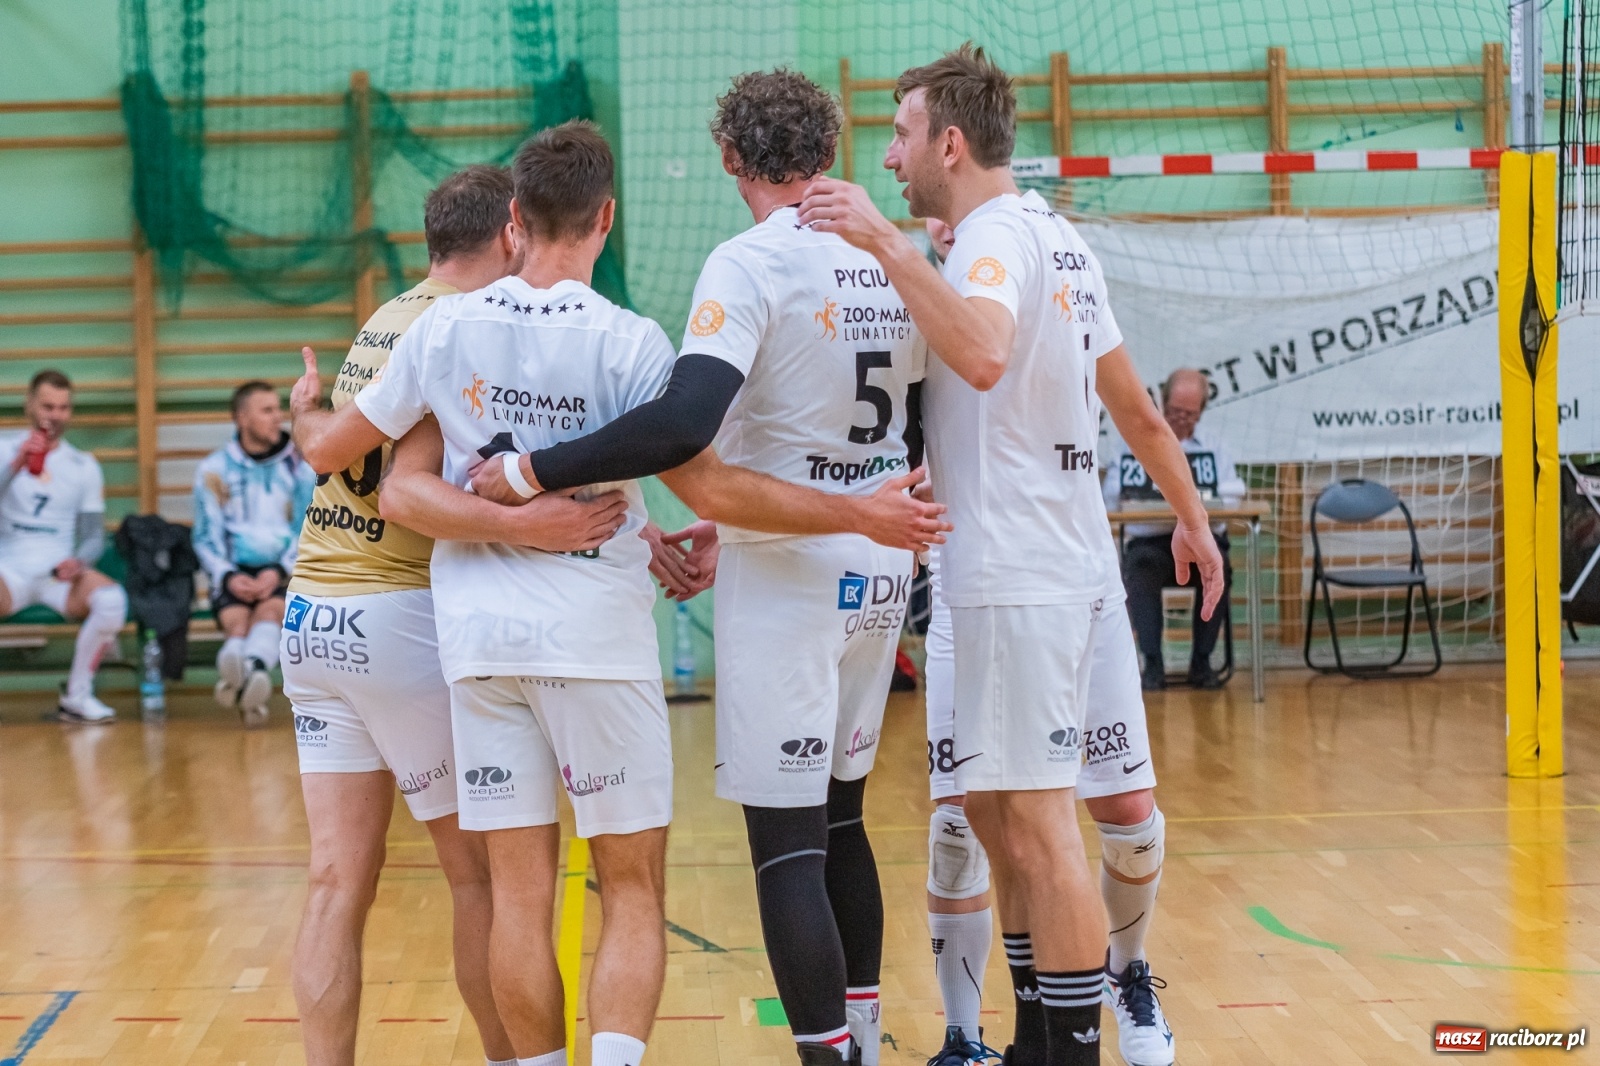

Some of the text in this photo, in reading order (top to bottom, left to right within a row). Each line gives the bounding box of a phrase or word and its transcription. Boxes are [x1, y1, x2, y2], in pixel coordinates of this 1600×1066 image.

[834, 268, 889, 288] PYCIU
[843, 307, 910, 323] ZOO-MAR
[1255, 339, 1297, 380] W
[1309, 269, 1499, 363] PORZĄD
[845, 326, 910, 341] LUNATYCY
[491, 385, 586, 413] ZOO-MAR
[847, 351, 893, 445] 5
[492, 406, 586, 431] LUNATYCY
[1121, 457, 1147, 487] 23
[1191, 455, 1216, 485] 18
[32, 492, 49, 517] 7
[306, 499, 386, 543] ropiDog
[871, 574, 910, 605] DK
[310, 604, 367, 639] DK
[844, 603, 904, 642] glass
[286, 628, 370, 665] glass
[296, 734, 328, 742] epol
[1083, 722, 1127, 746] ZOO
[1086, 736, 1130, 760] MAR
[780, 756, 827, 767] wepol
[467, 784, 515, 795] wepol
